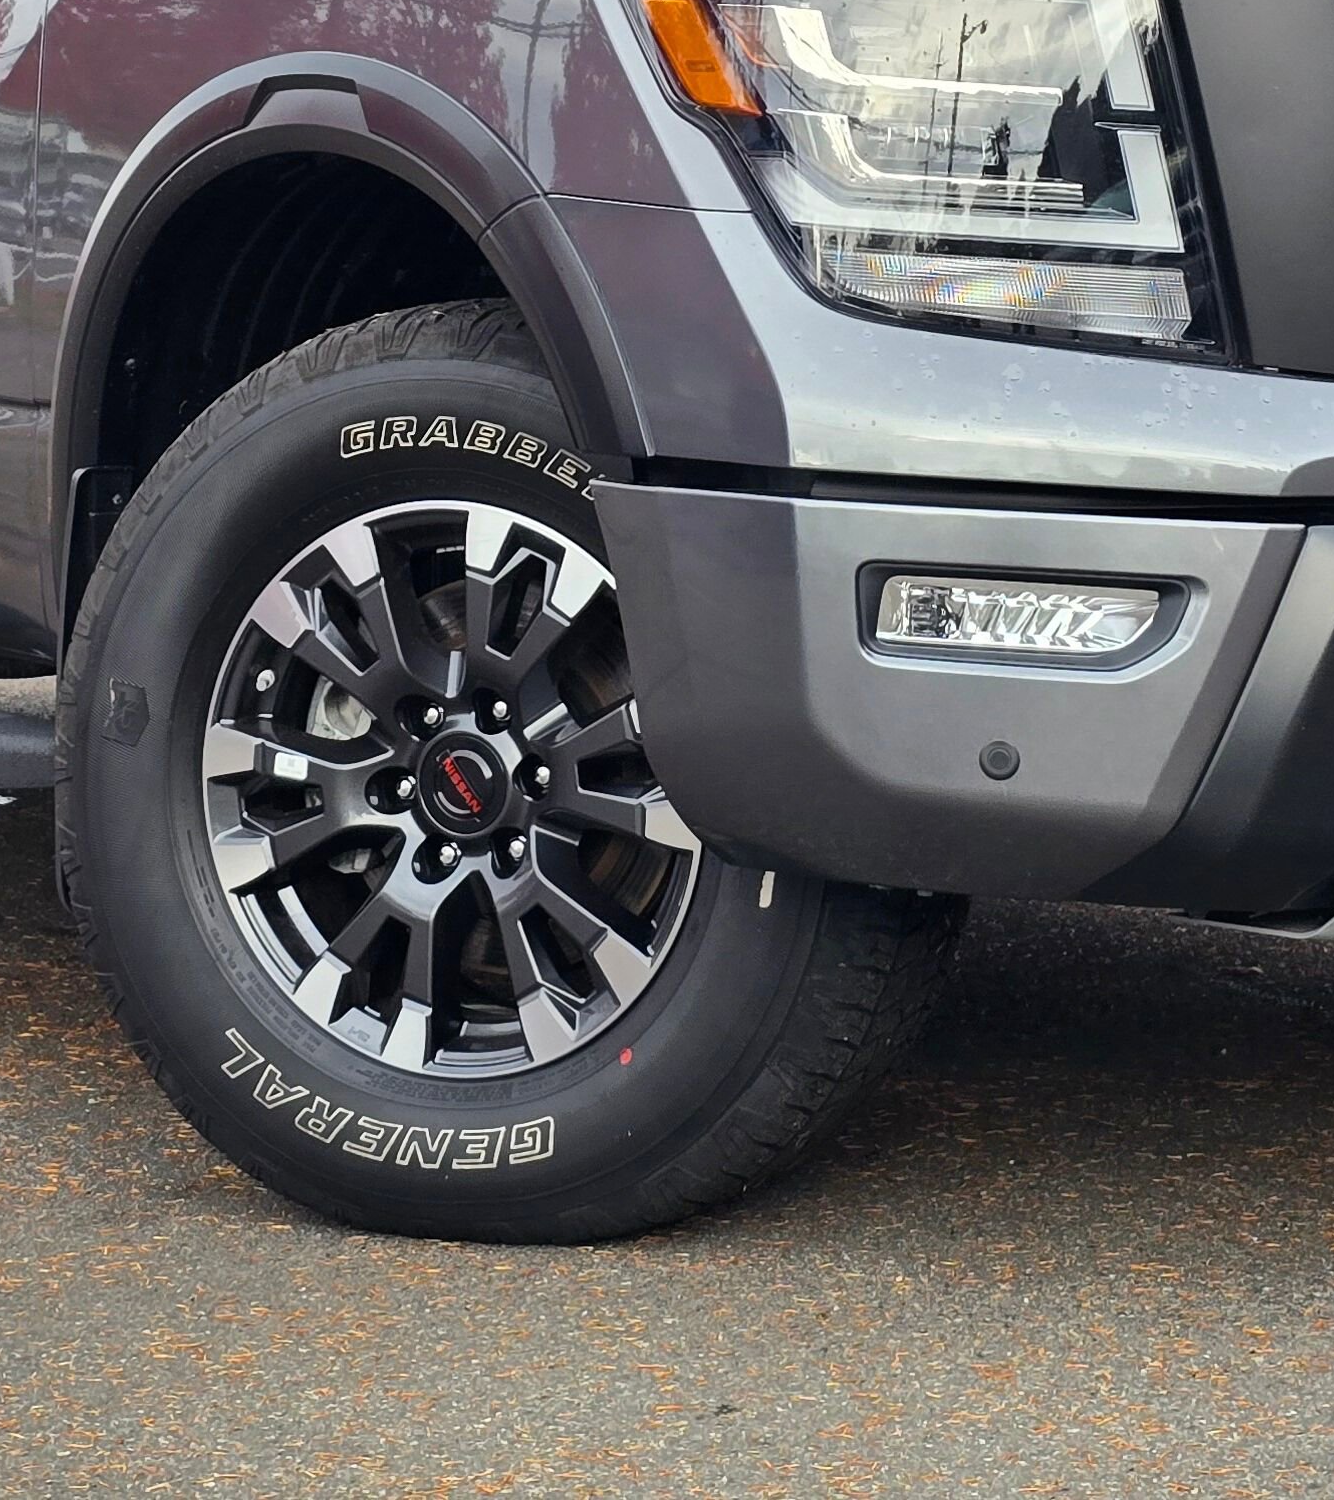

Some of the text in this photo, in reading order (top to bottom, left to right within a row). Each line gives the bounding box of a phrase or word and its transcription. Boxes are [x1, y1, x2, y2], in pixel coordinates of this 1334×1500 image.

[340, 415, 595, 501] GRABBE
[442, 756, 482, 813] NISSAN
[220, 1027, 555, 1169] GENERAL
